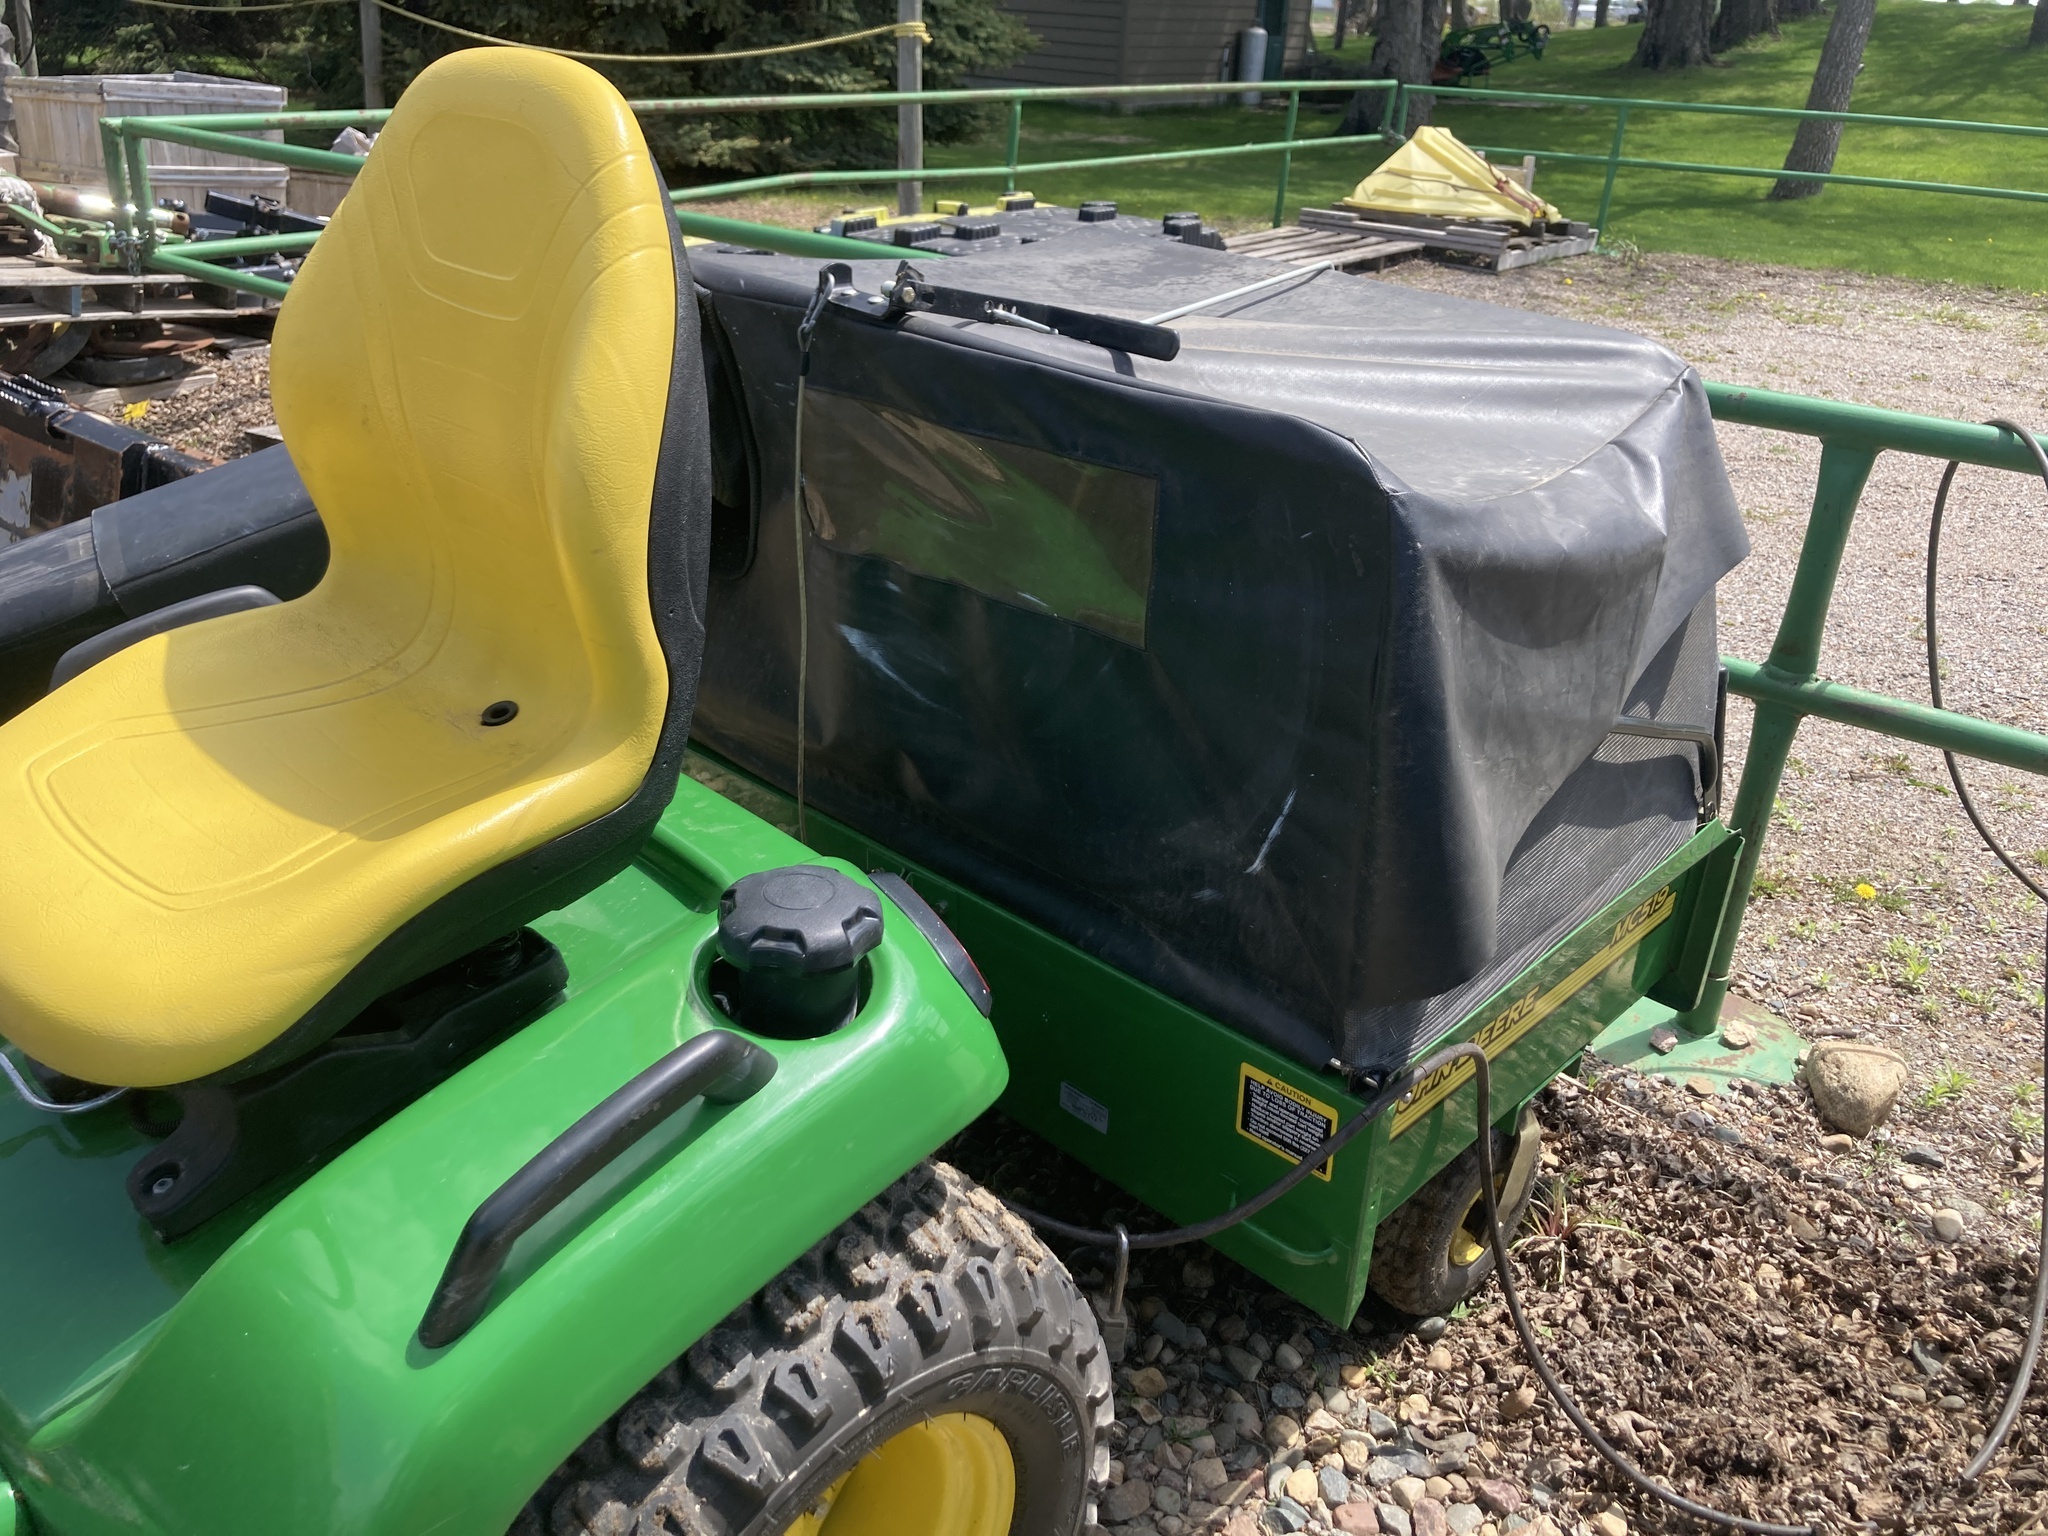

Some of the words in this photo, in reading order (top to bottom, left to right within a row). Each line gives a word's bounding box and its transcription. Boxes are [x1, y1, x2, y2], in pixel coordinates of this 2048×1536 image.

[1610, 884, 1671, 946] MC519
[1249, 1084, 1261, 1095] DUE
[1262, 1090, 1270, 1099] TO
[1270, 1095, 1286, 1108] LOSS
[1286, 1103, 1296, 1113] OF
[1296, 1108, 1326, 1129] TRACTION
[1250, 1078, 1265, 1091] HELP
[1265, 1087, 1283, 1101] AVOID
[1283, 1096, 1305, 1112] BODILY
[1305, 1108, 1327, 1123] INJURY
[1268, 1100, 1278, 1110] and
[1274, 1080, 1312, 1106] CAUTION
[944, 1367, 1082, 1459] CARLISLE
